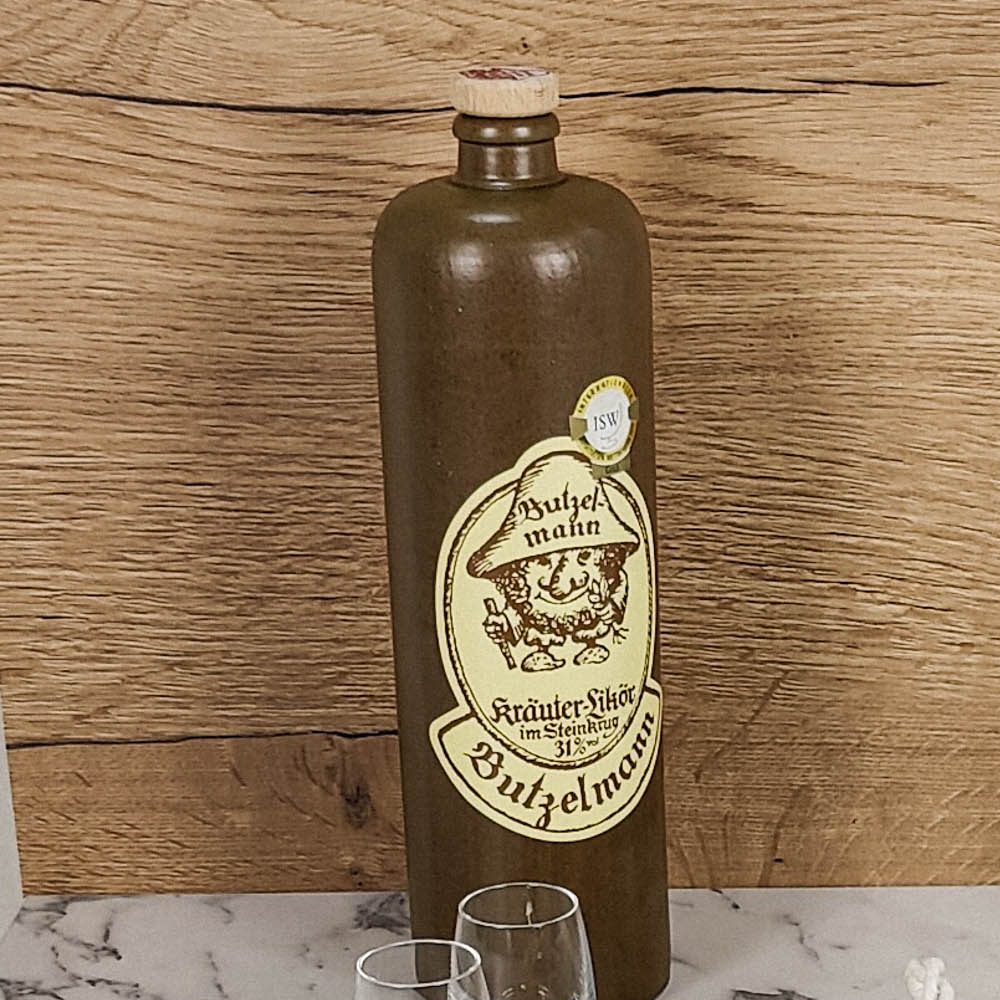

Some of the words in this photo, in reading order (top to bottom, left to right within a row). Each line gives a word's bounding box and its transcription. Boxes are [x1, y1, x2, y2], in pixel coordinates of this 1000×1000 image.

[593, 408, 619, 432] ISW
[523, 519, 601, 548] mann
[490, 683, 636, 727] Kräuter-Likör
[519, 724, 542, 740] im
[542, 716, 619, 739] Steinkrug
[464, 711, 655, 830] Butzelmann
